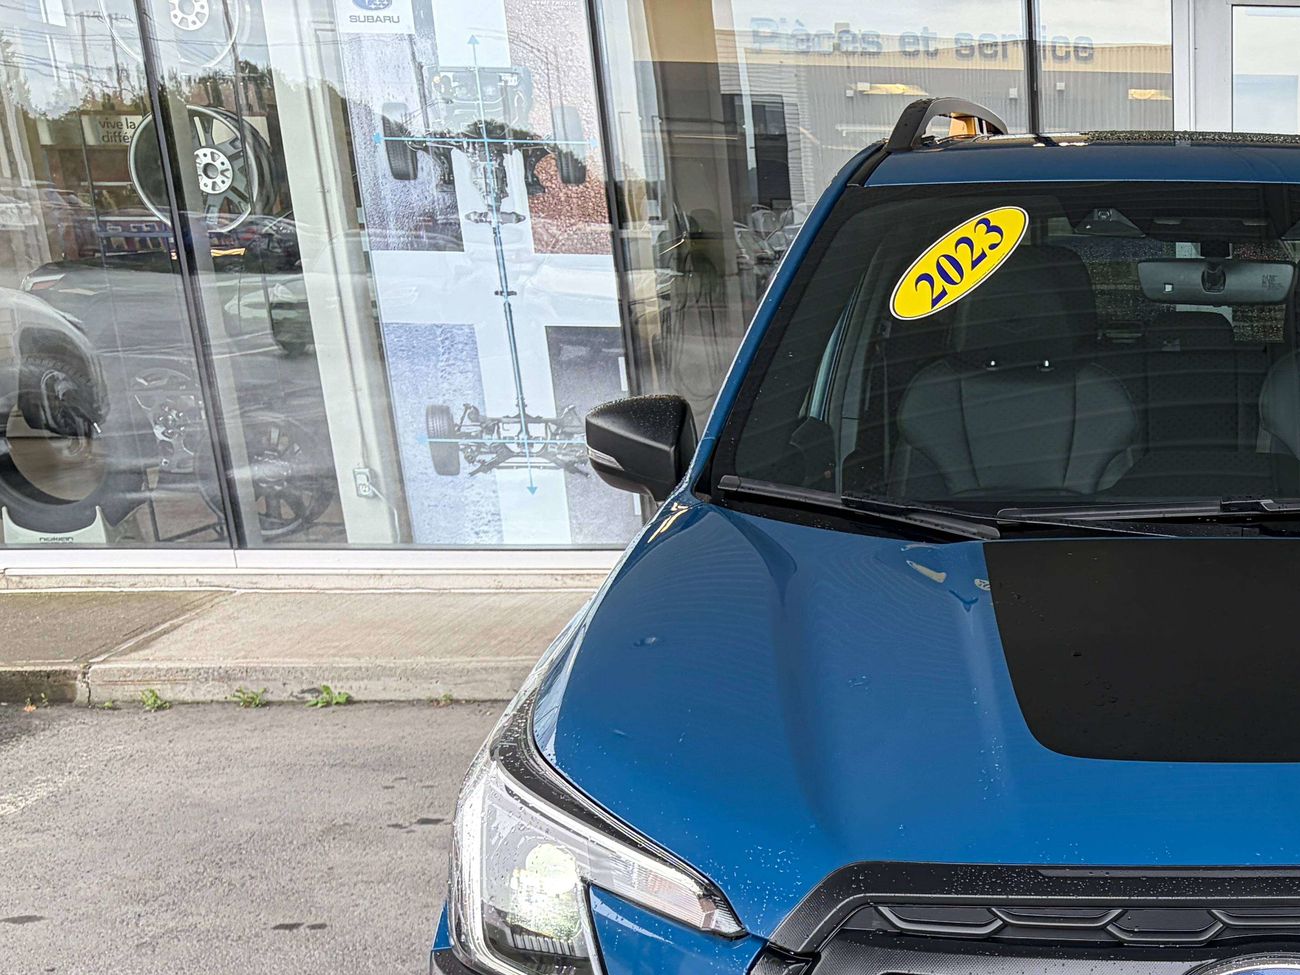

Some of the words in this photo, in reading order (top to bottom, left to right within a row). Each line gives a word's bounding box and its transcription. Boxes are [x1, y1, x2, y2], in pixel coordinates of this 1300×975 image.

[349, 15, 401, 24] SUBARU
[901, 26, 937, 58] et
[954, 25, 1094, 64] serice
[98, 117, 123, 130] vive
[125, 117, 136, 130] la
[101, 131, 133, 143] diffé
[914, 217, 1004, 310] 2023
